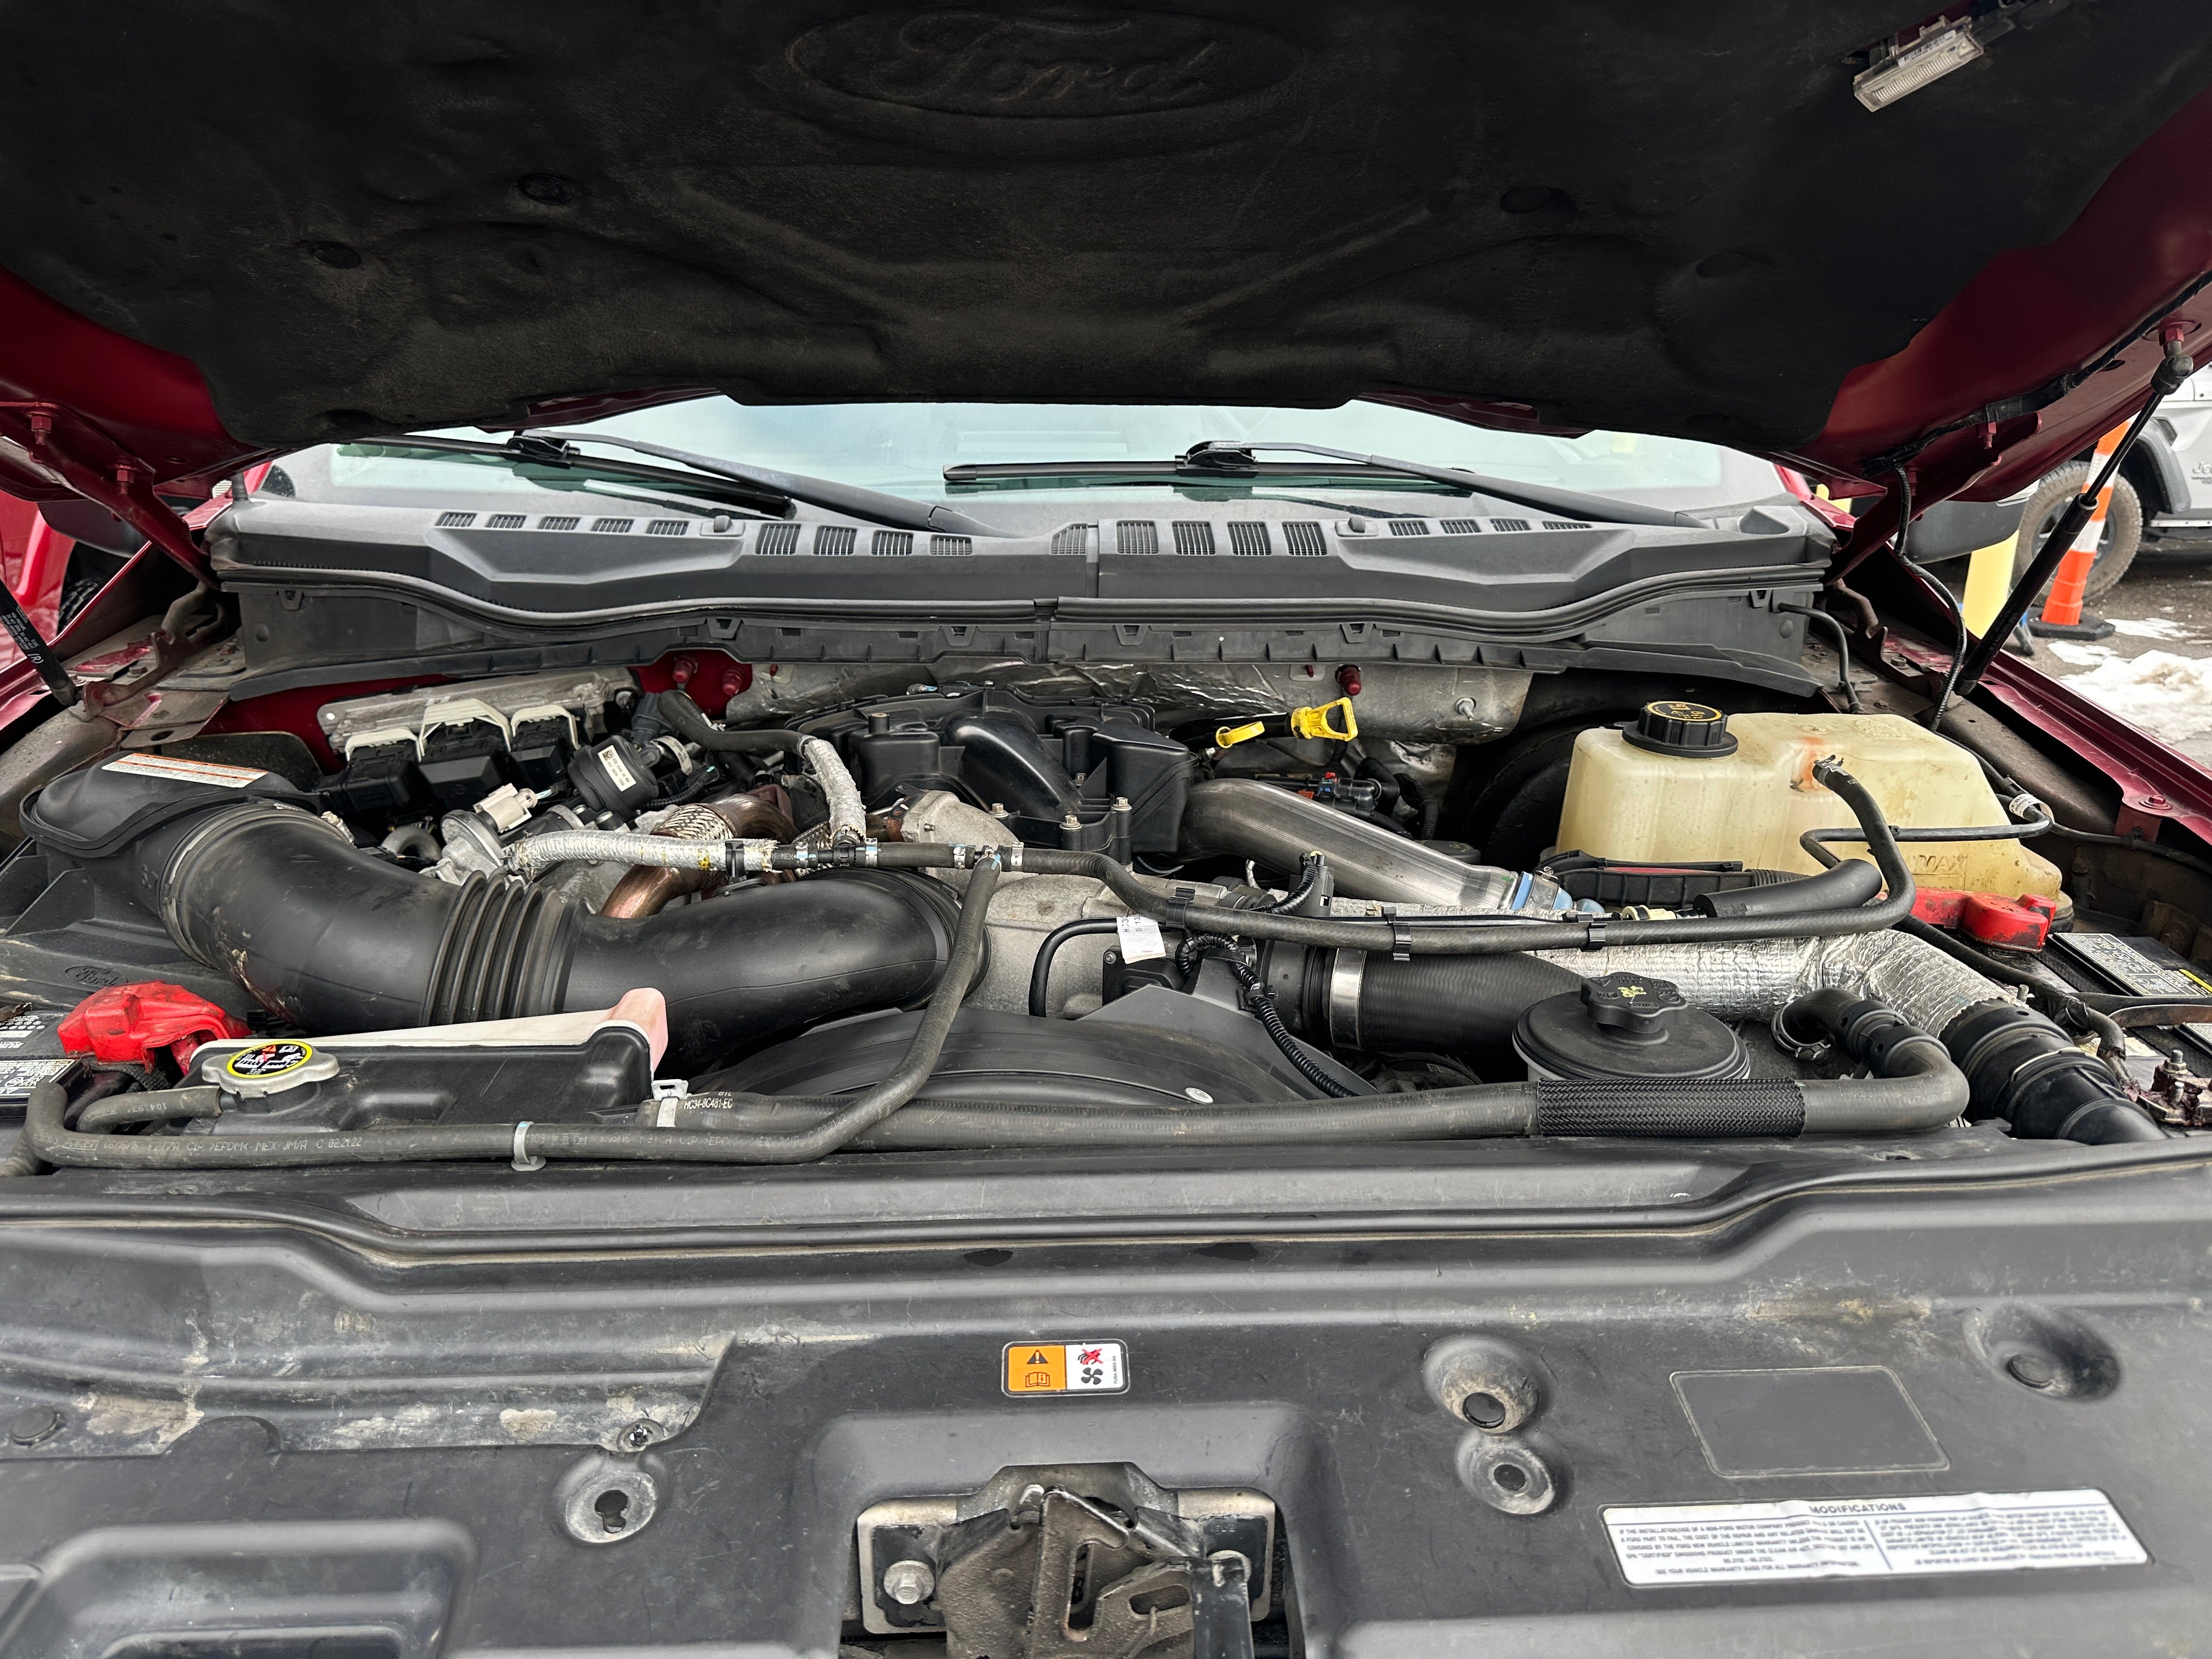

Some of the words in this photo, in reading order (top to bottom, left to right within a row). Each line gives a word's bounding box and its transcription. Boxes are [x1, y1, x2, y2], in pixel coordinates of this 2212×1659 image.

[868, 13, 1219, 102] Ford
[75, 967, 120, 986] Ford
[255, 1141, 278, 1151] MEX
[316, 1139, 324, 1148] C
[1809, 1503, 1906, 1514] MODIFICATIONS
[1785, 1520, 1810, 1528] PRODUCT
